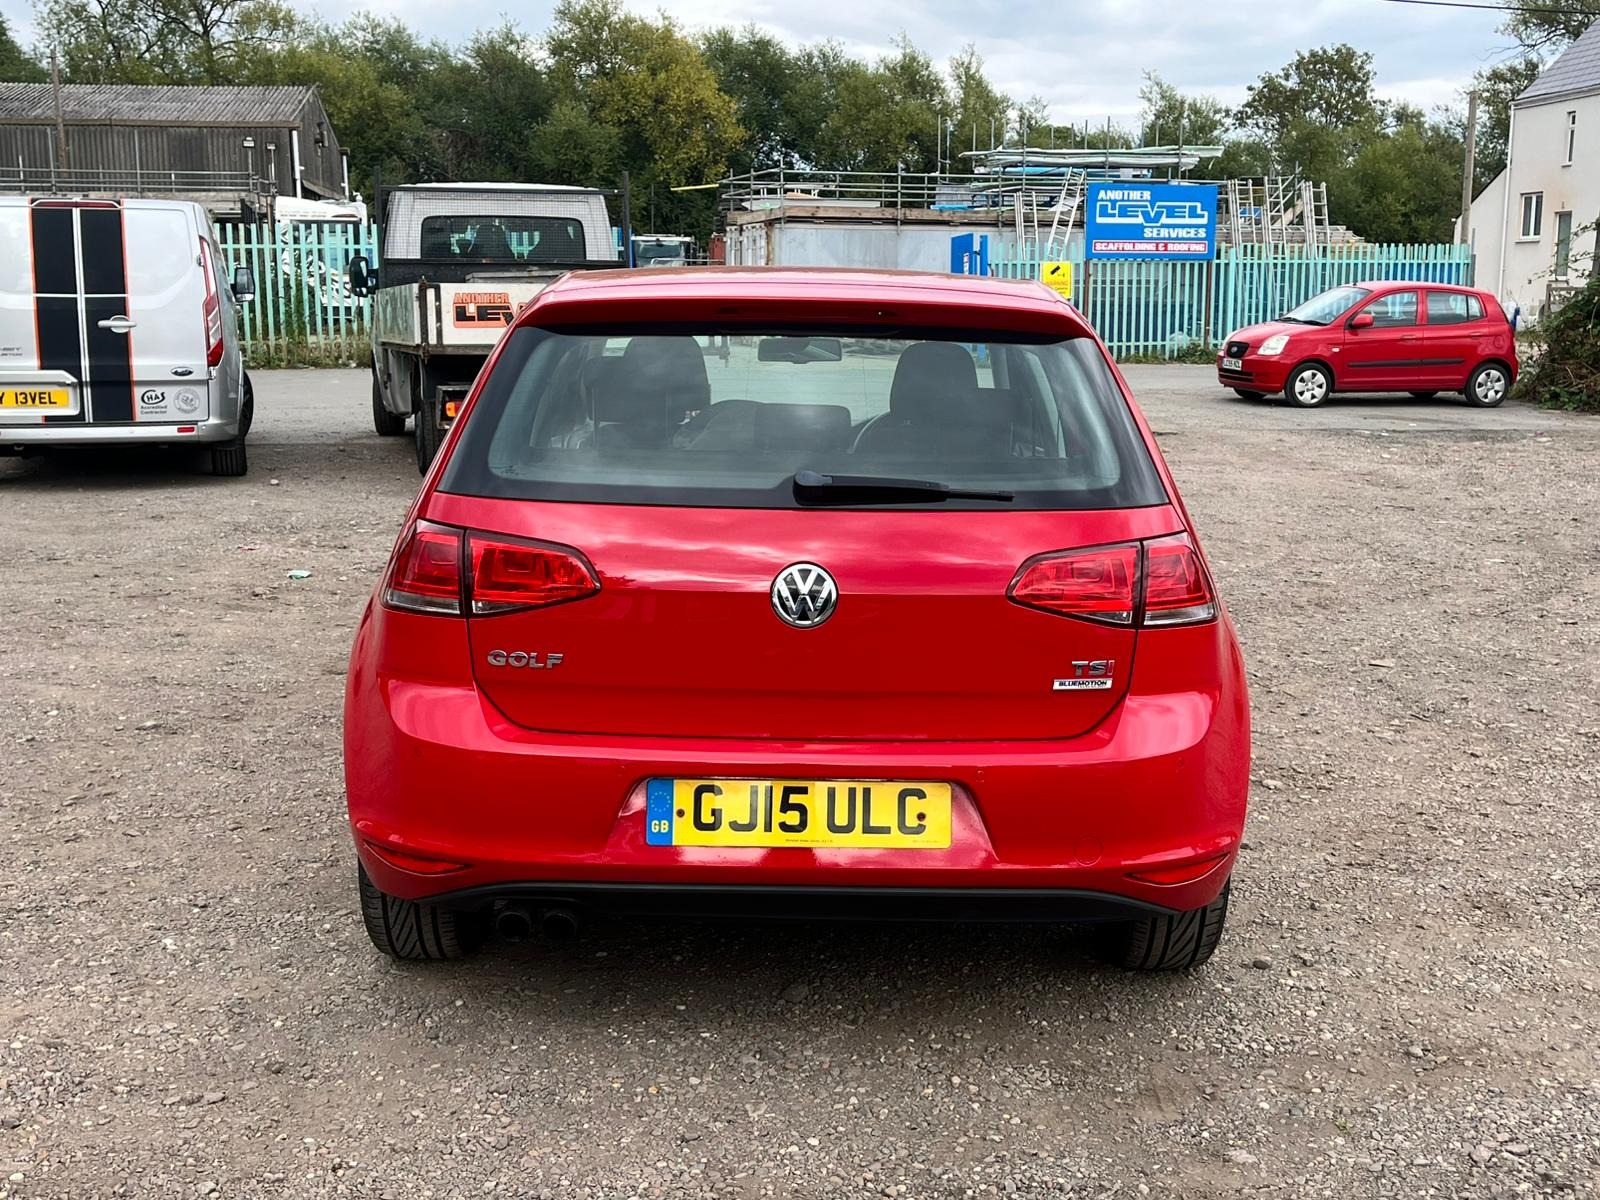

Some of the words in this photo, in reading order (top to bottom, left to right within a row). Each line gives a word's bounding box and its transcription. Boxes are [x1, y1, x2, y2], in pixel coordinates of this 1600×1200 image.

[1098, 190, 1151, 201] ANOTHER
[1096, 202, 1208, 226] LEVEL
[1143, 227, 1207, 238] SERVICES
[1095, 242, 1156, 251] SCAFFOLDING
[1168, 243, 1205, 251] ROOFING
[454, 293, 509, 303] ANOTHER
[453, 303, 527, 328] LEV
[14, 391, 58, 405] 13VEL
[487, 650, 563, 669] GOLF
[1071, 660, 1115, 676] TSI
[692, 784, 809, 833] GJ15
[826, 786, 927, 835] ULC
[650, 819, 669, 833] GB
